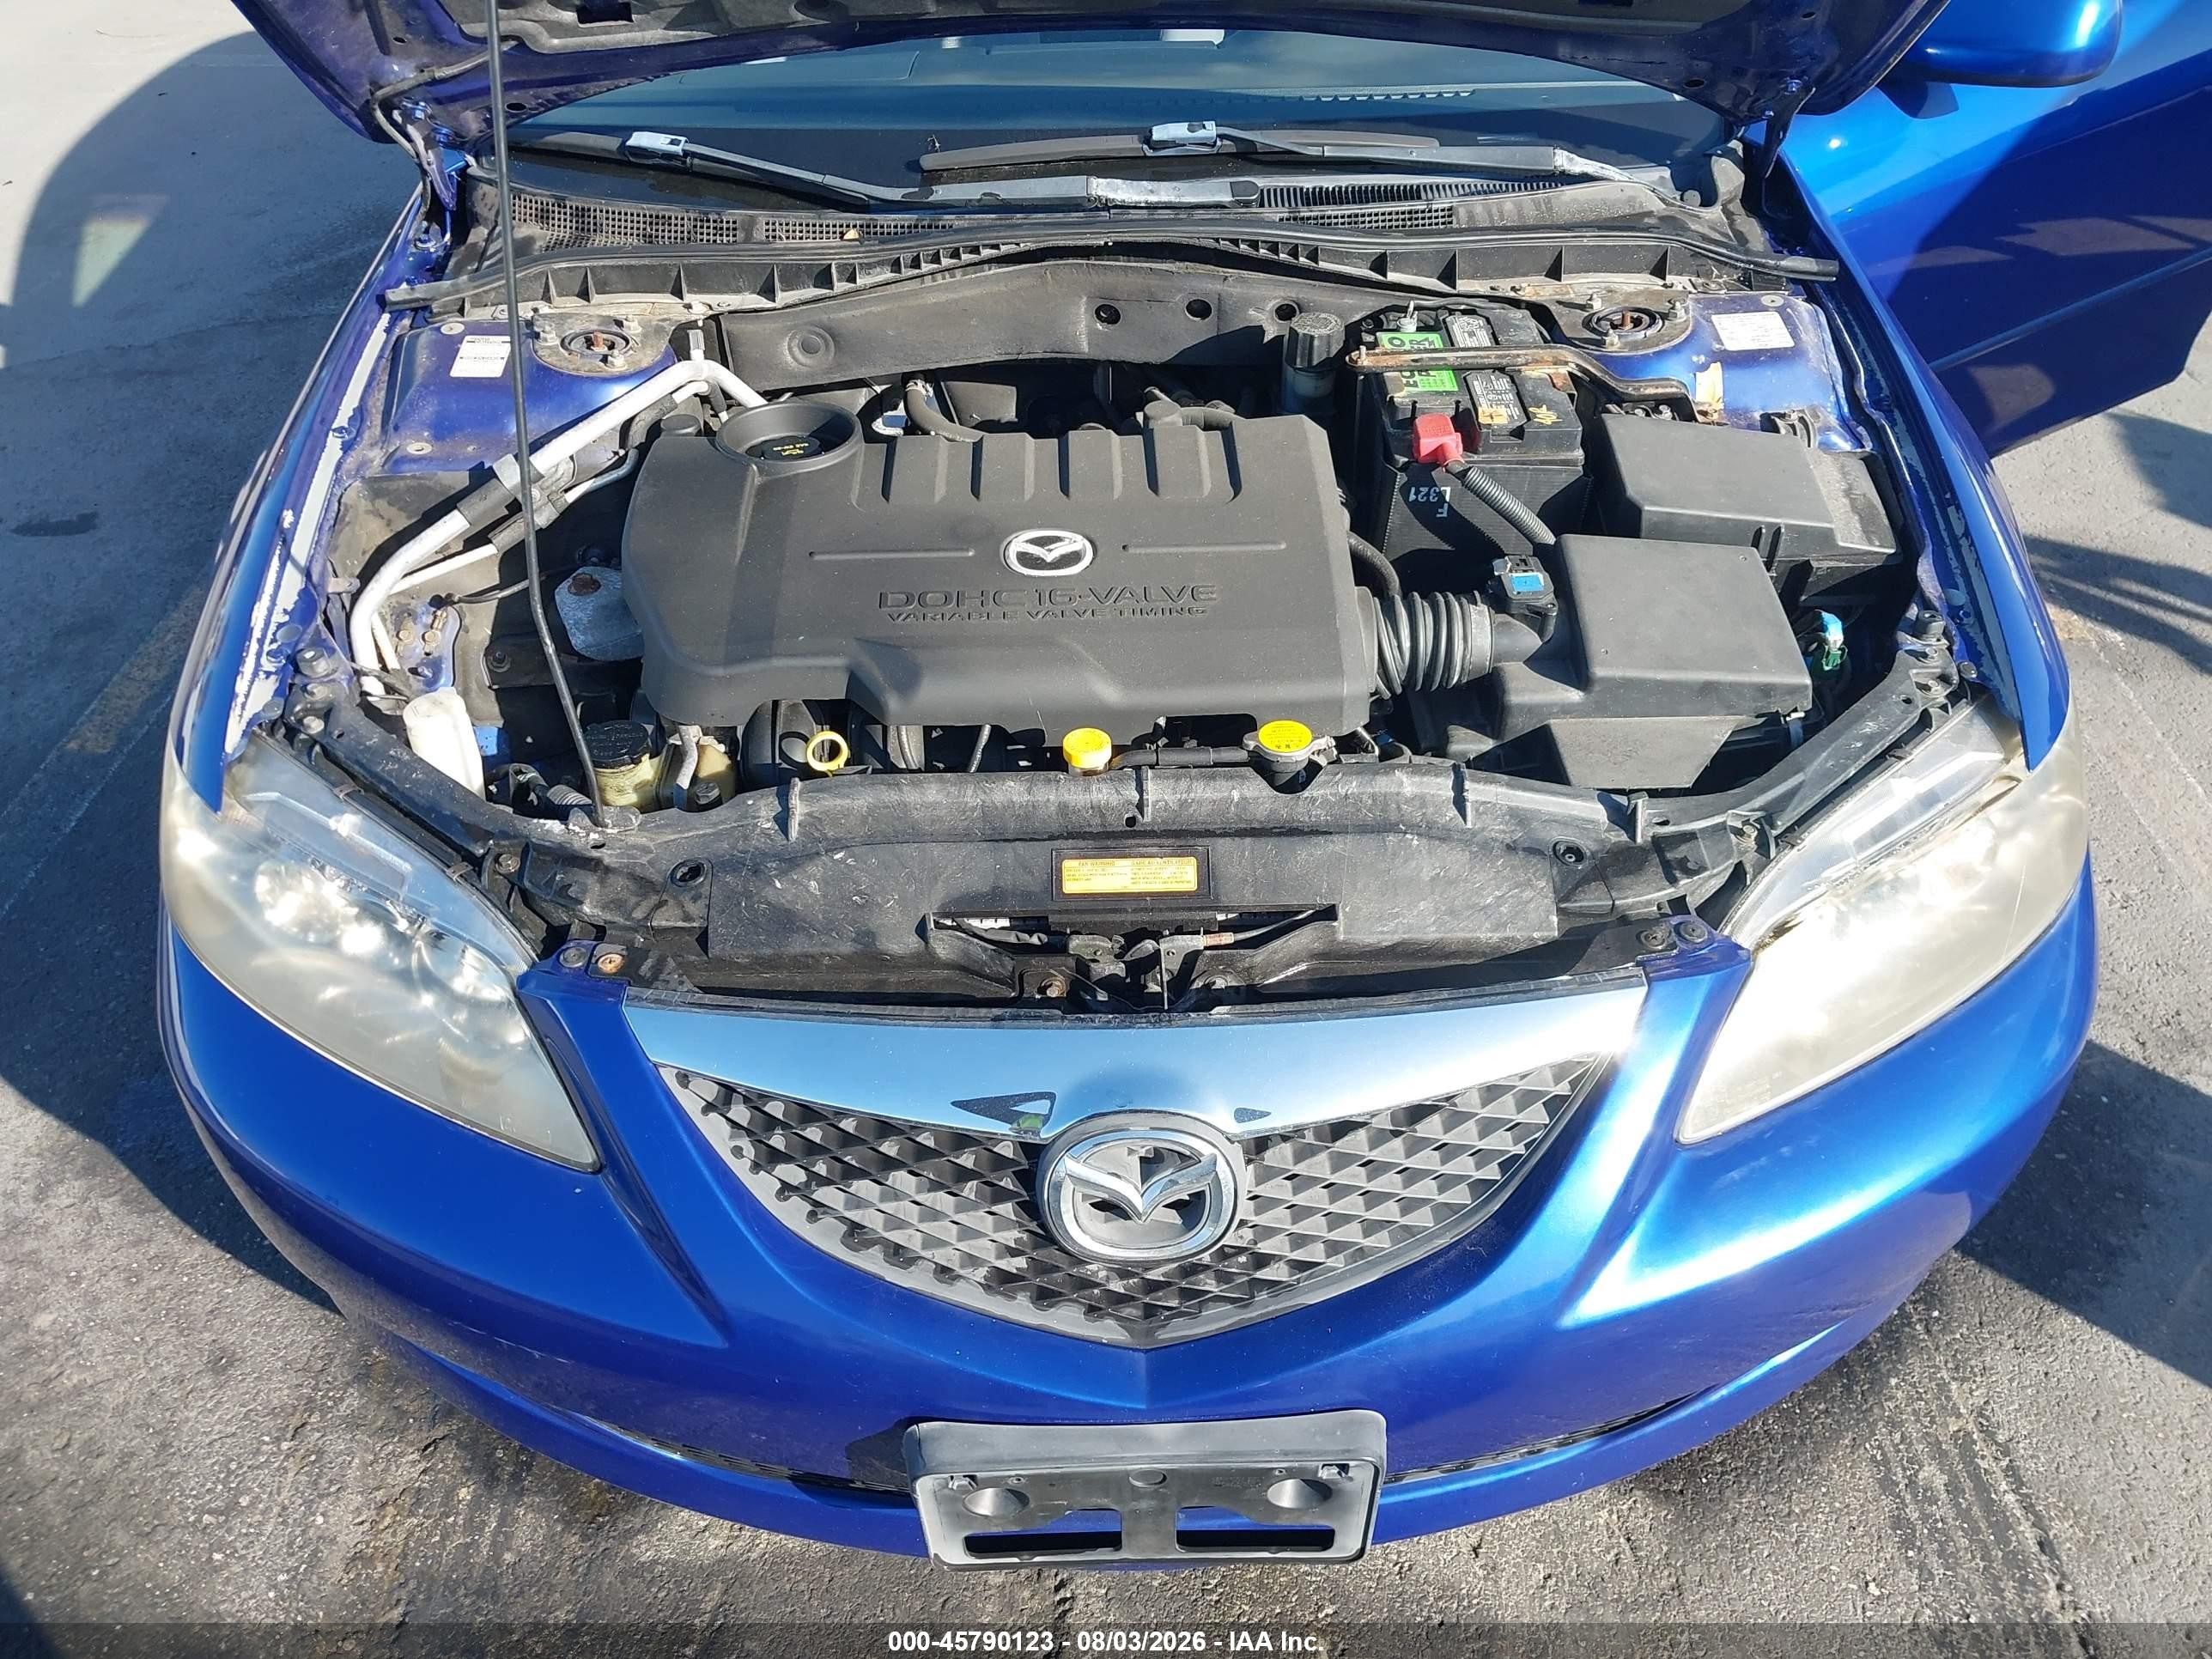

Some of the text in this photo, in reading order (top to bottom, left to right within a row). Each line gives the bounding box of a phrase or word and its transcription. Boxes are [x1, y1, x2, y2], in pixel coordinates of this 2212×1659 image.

[1408, 486, 1451, 502] L321
[1436, 502, 1449, 518] F
[878, 590, 1029, 610] DOHC
[887, 605, 1209, 623] VARIABLE VALVE TIMING
